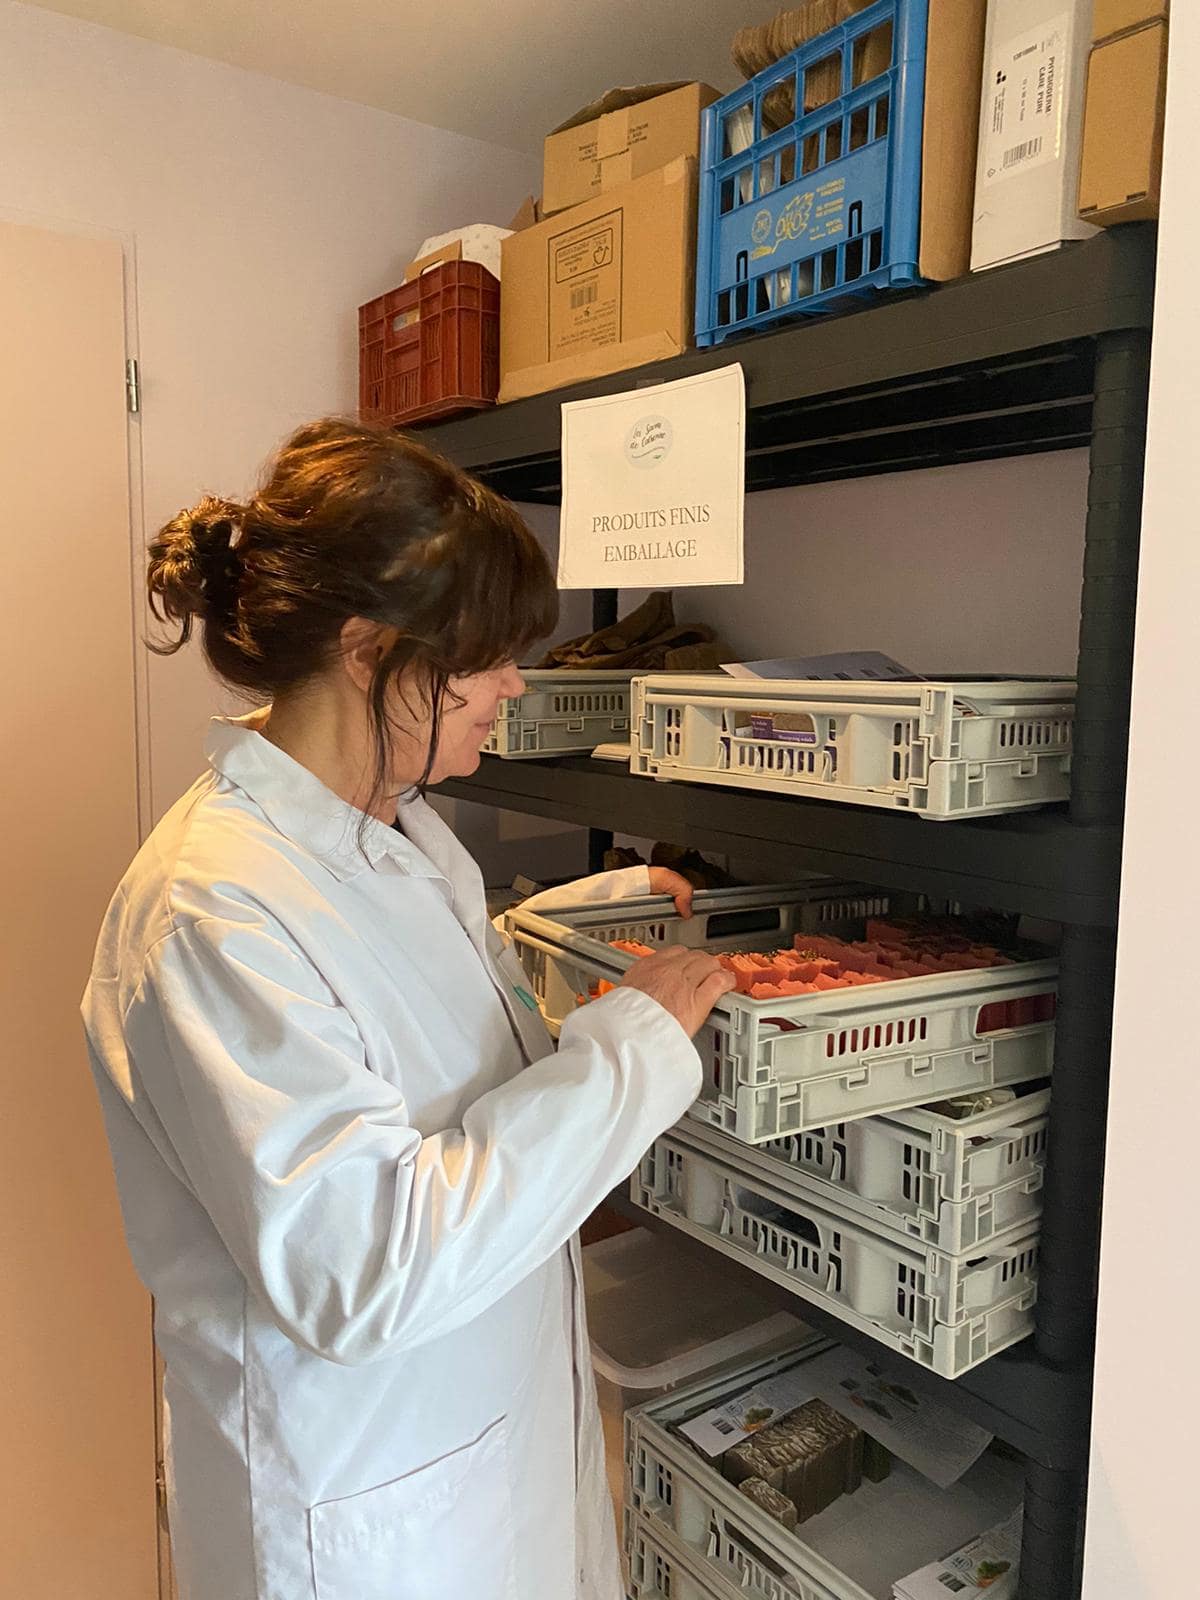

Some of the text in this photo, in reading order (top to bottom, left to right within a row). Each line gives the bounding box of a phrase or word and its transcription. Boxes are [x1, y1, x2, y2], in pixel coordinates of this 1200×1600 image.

[1035, 66, 1046, 114] CARE PURE
[592, 504, 711, 533] PRODUITS FINIS
[603, 539, 697, 562] EMBALLAGE
